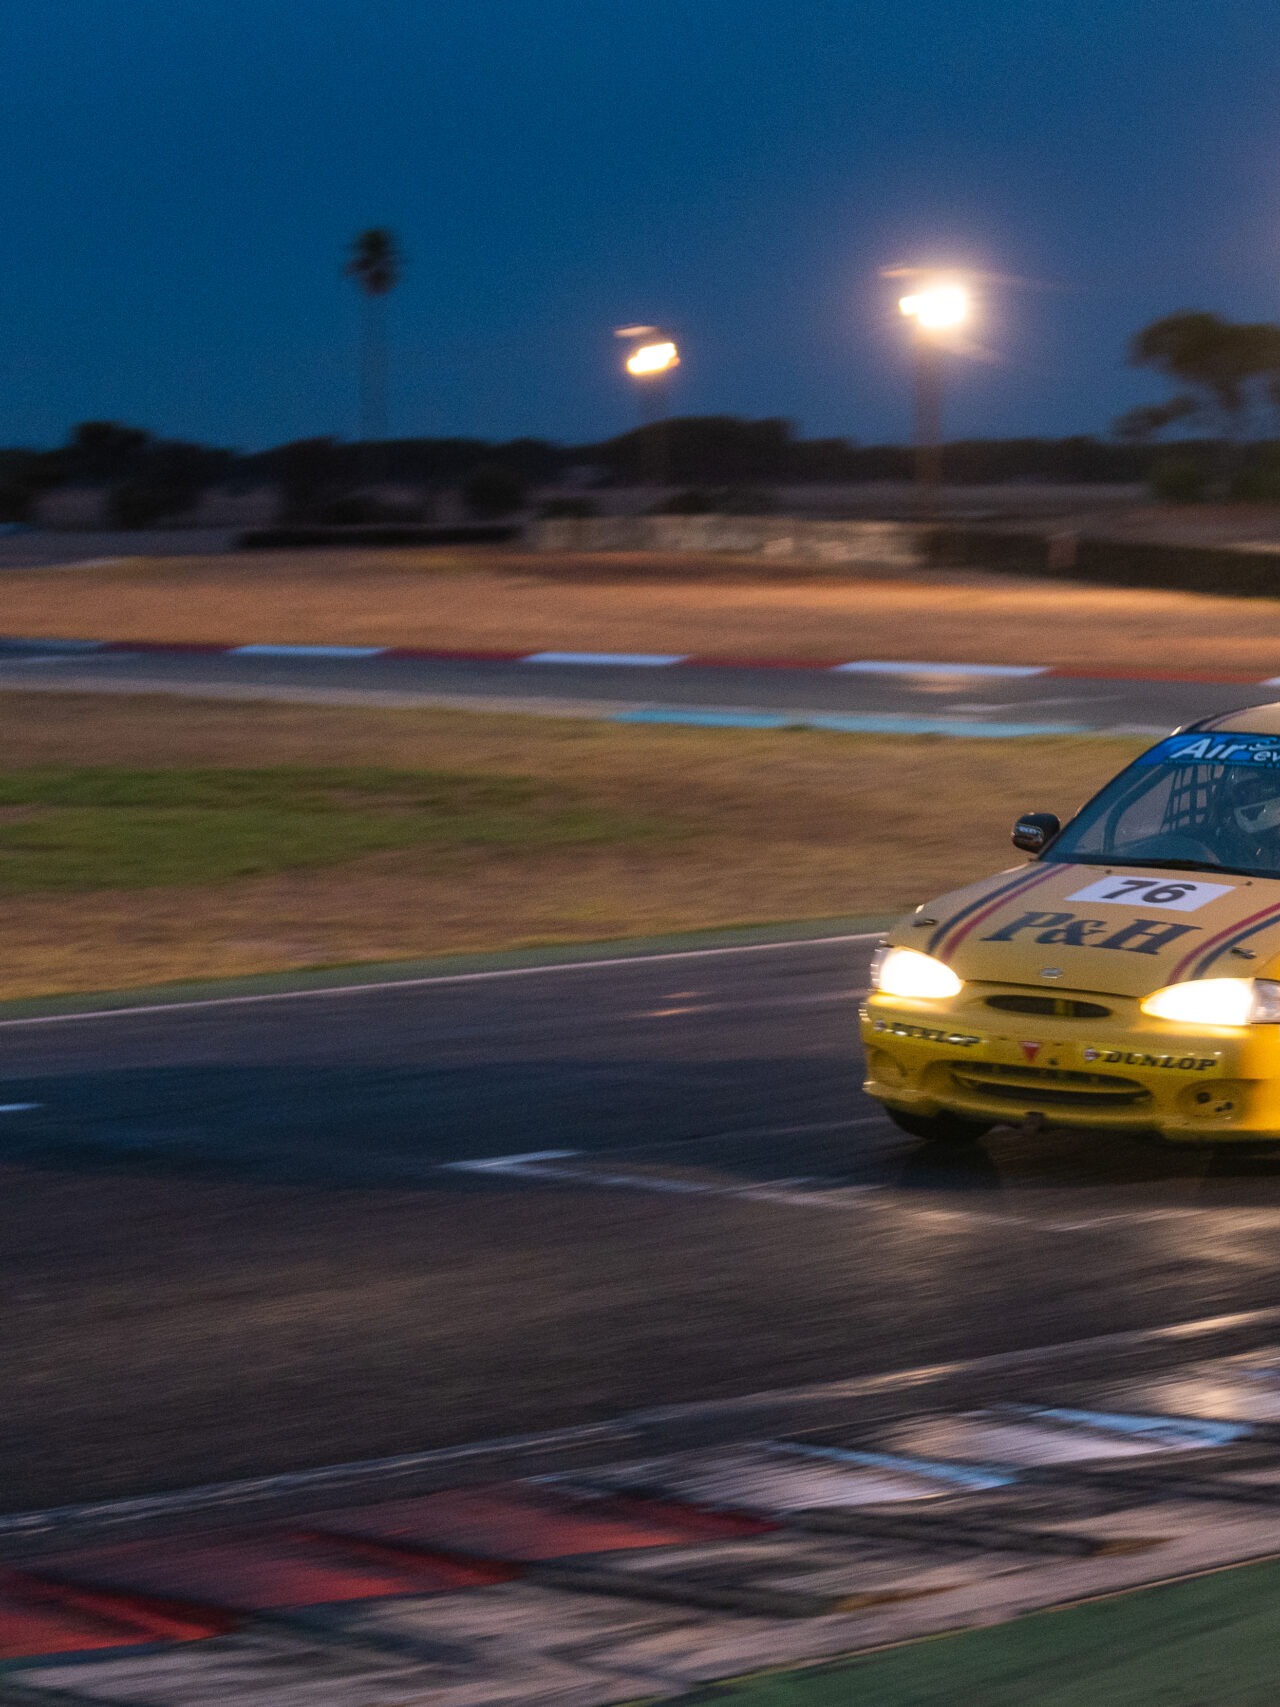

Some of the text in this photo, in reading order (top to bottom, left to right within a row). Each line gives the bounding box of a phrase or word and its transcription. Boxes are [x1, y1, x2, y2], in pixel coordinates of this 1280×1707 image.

[1169, 737, 1247, 760] Air
[1100, 879, 1197, 904] 76
[979, 911, 1203, 956] P&H
[1102, 1051, 1218, 1071] DUNLOP
